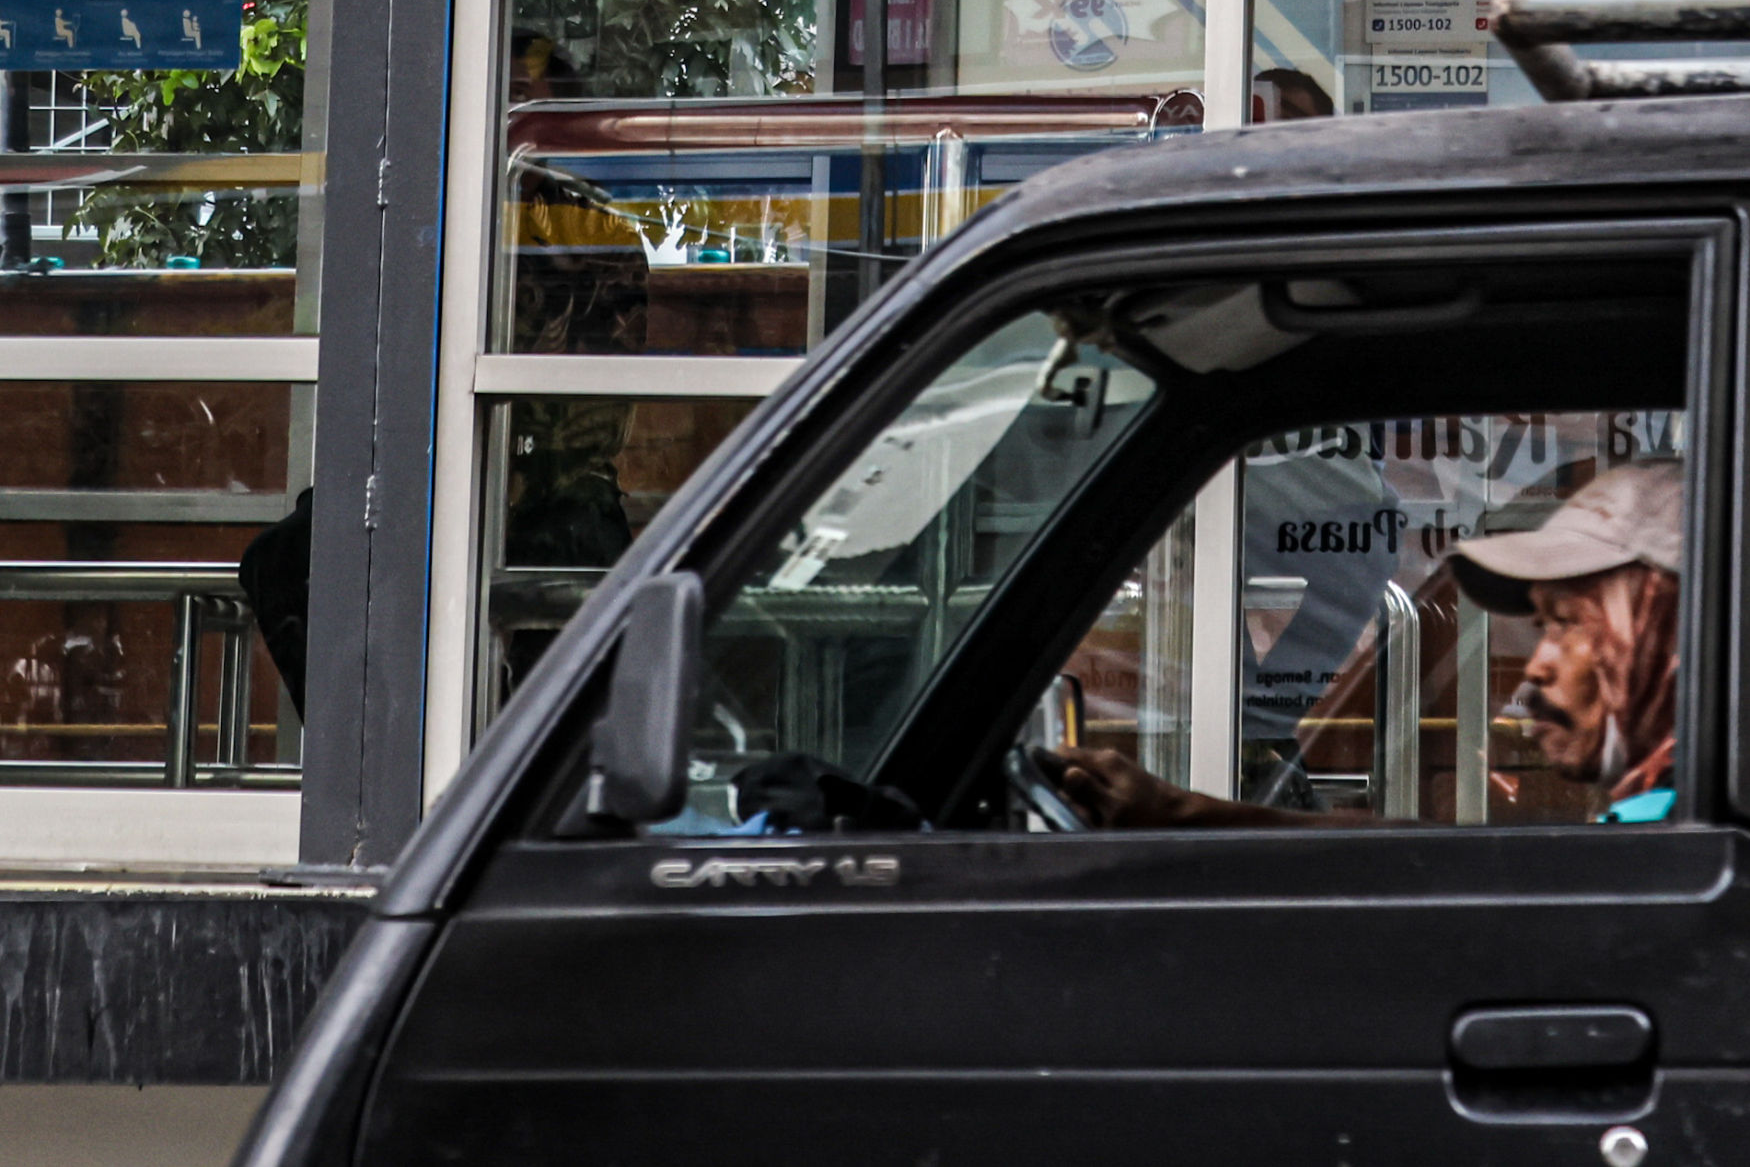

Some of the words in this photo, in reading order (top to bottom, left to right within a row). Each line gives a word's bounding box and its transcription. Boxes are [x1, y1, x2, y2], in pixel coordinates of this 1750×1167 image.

[1388, 18, 1452, 32] 1500-102
[1375, 64, 1484, 87] 1500-102
[651, 857, 826, 887] CARRY
